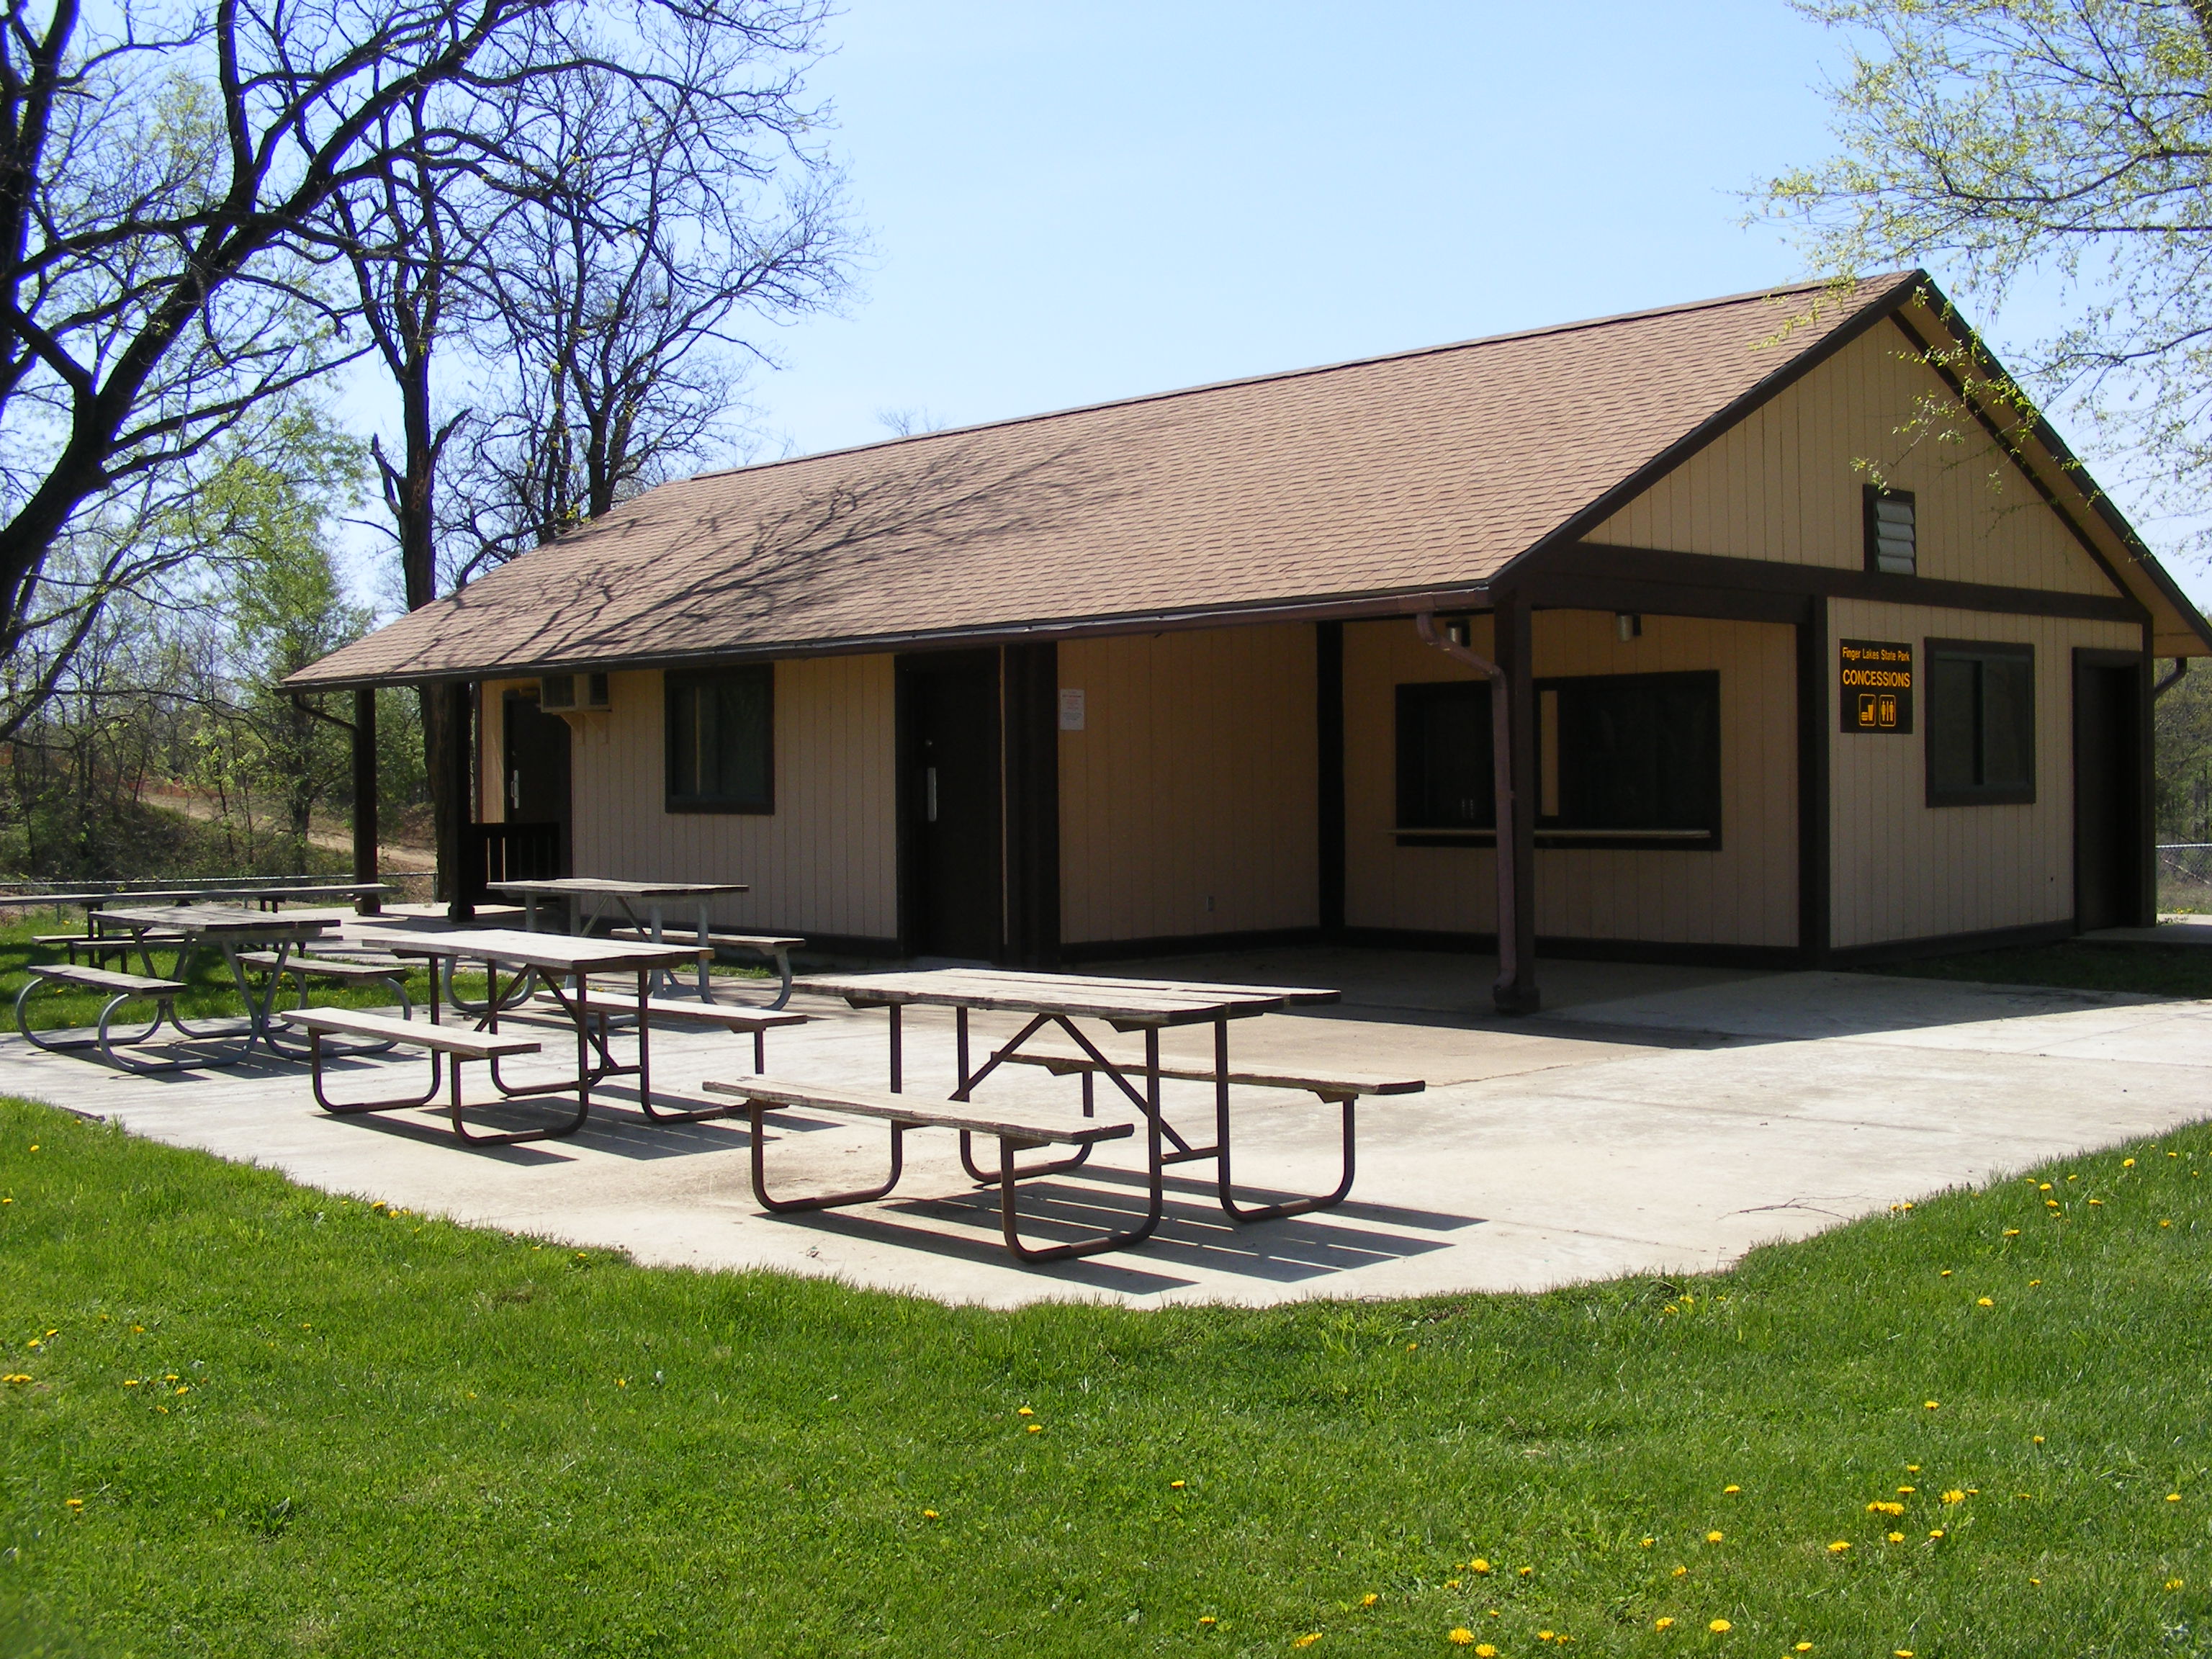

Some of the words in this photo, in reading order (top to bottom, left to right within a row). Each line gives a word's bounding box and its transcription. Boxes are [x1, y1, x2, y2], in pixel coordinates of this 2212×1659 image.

[1843, 647, 1861, 661] Finger
[1862, 648, 1879, 660] Lakes
[1881, 649, 1896, 661] State
[1897, 651, 1910, 662] Park
[1843, 669, 1911, 688] CONCESSIONS
